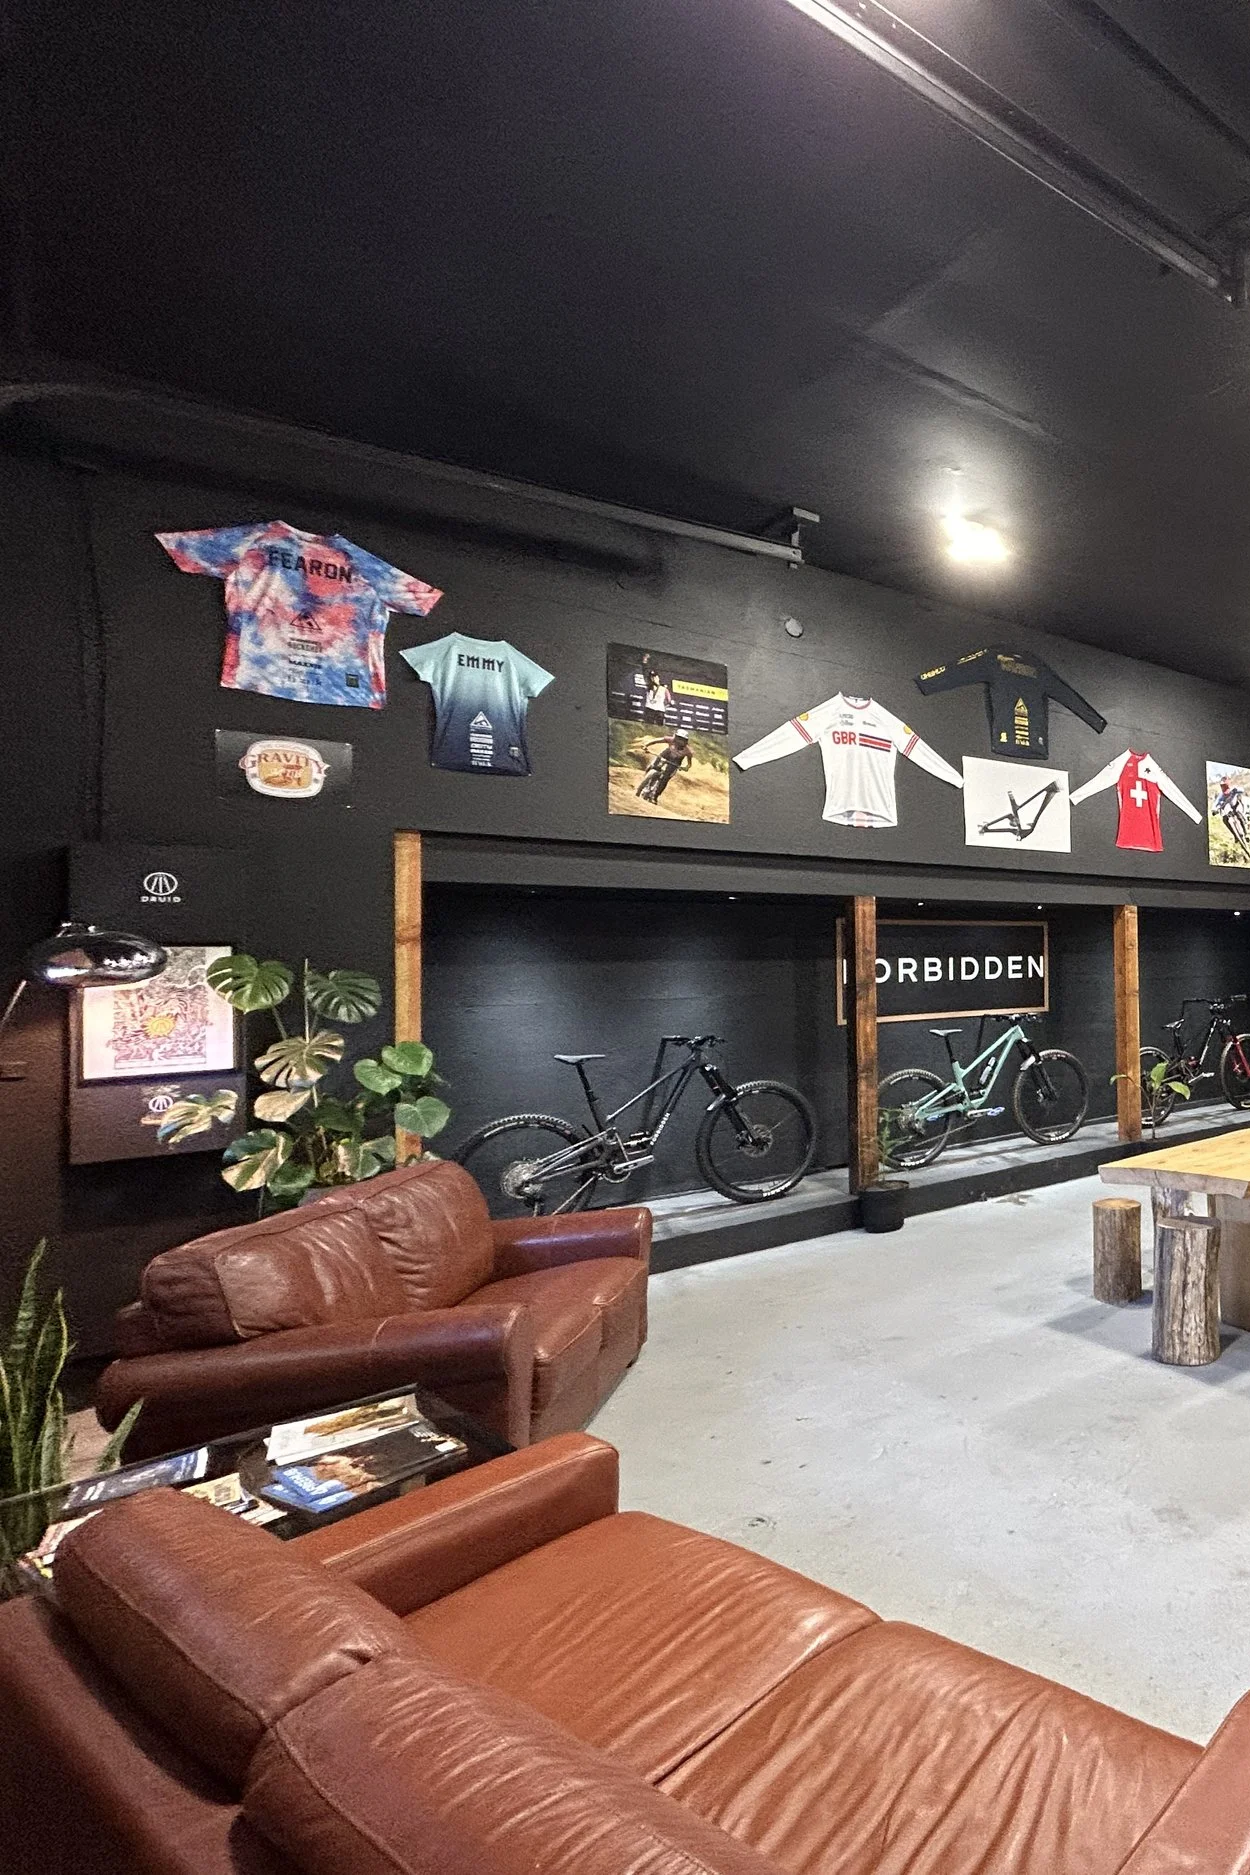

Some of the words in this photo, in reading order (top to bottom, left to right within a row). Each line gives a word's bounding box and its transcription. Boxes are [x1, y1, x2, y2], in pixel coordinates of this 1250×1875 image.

[269, 549, 352, 584] FEARON
[457, 653, 504, 673] EMMY
[832, 730, 858, 746] GBR
[843, 955, 1044, 986] ORBIDDEN
